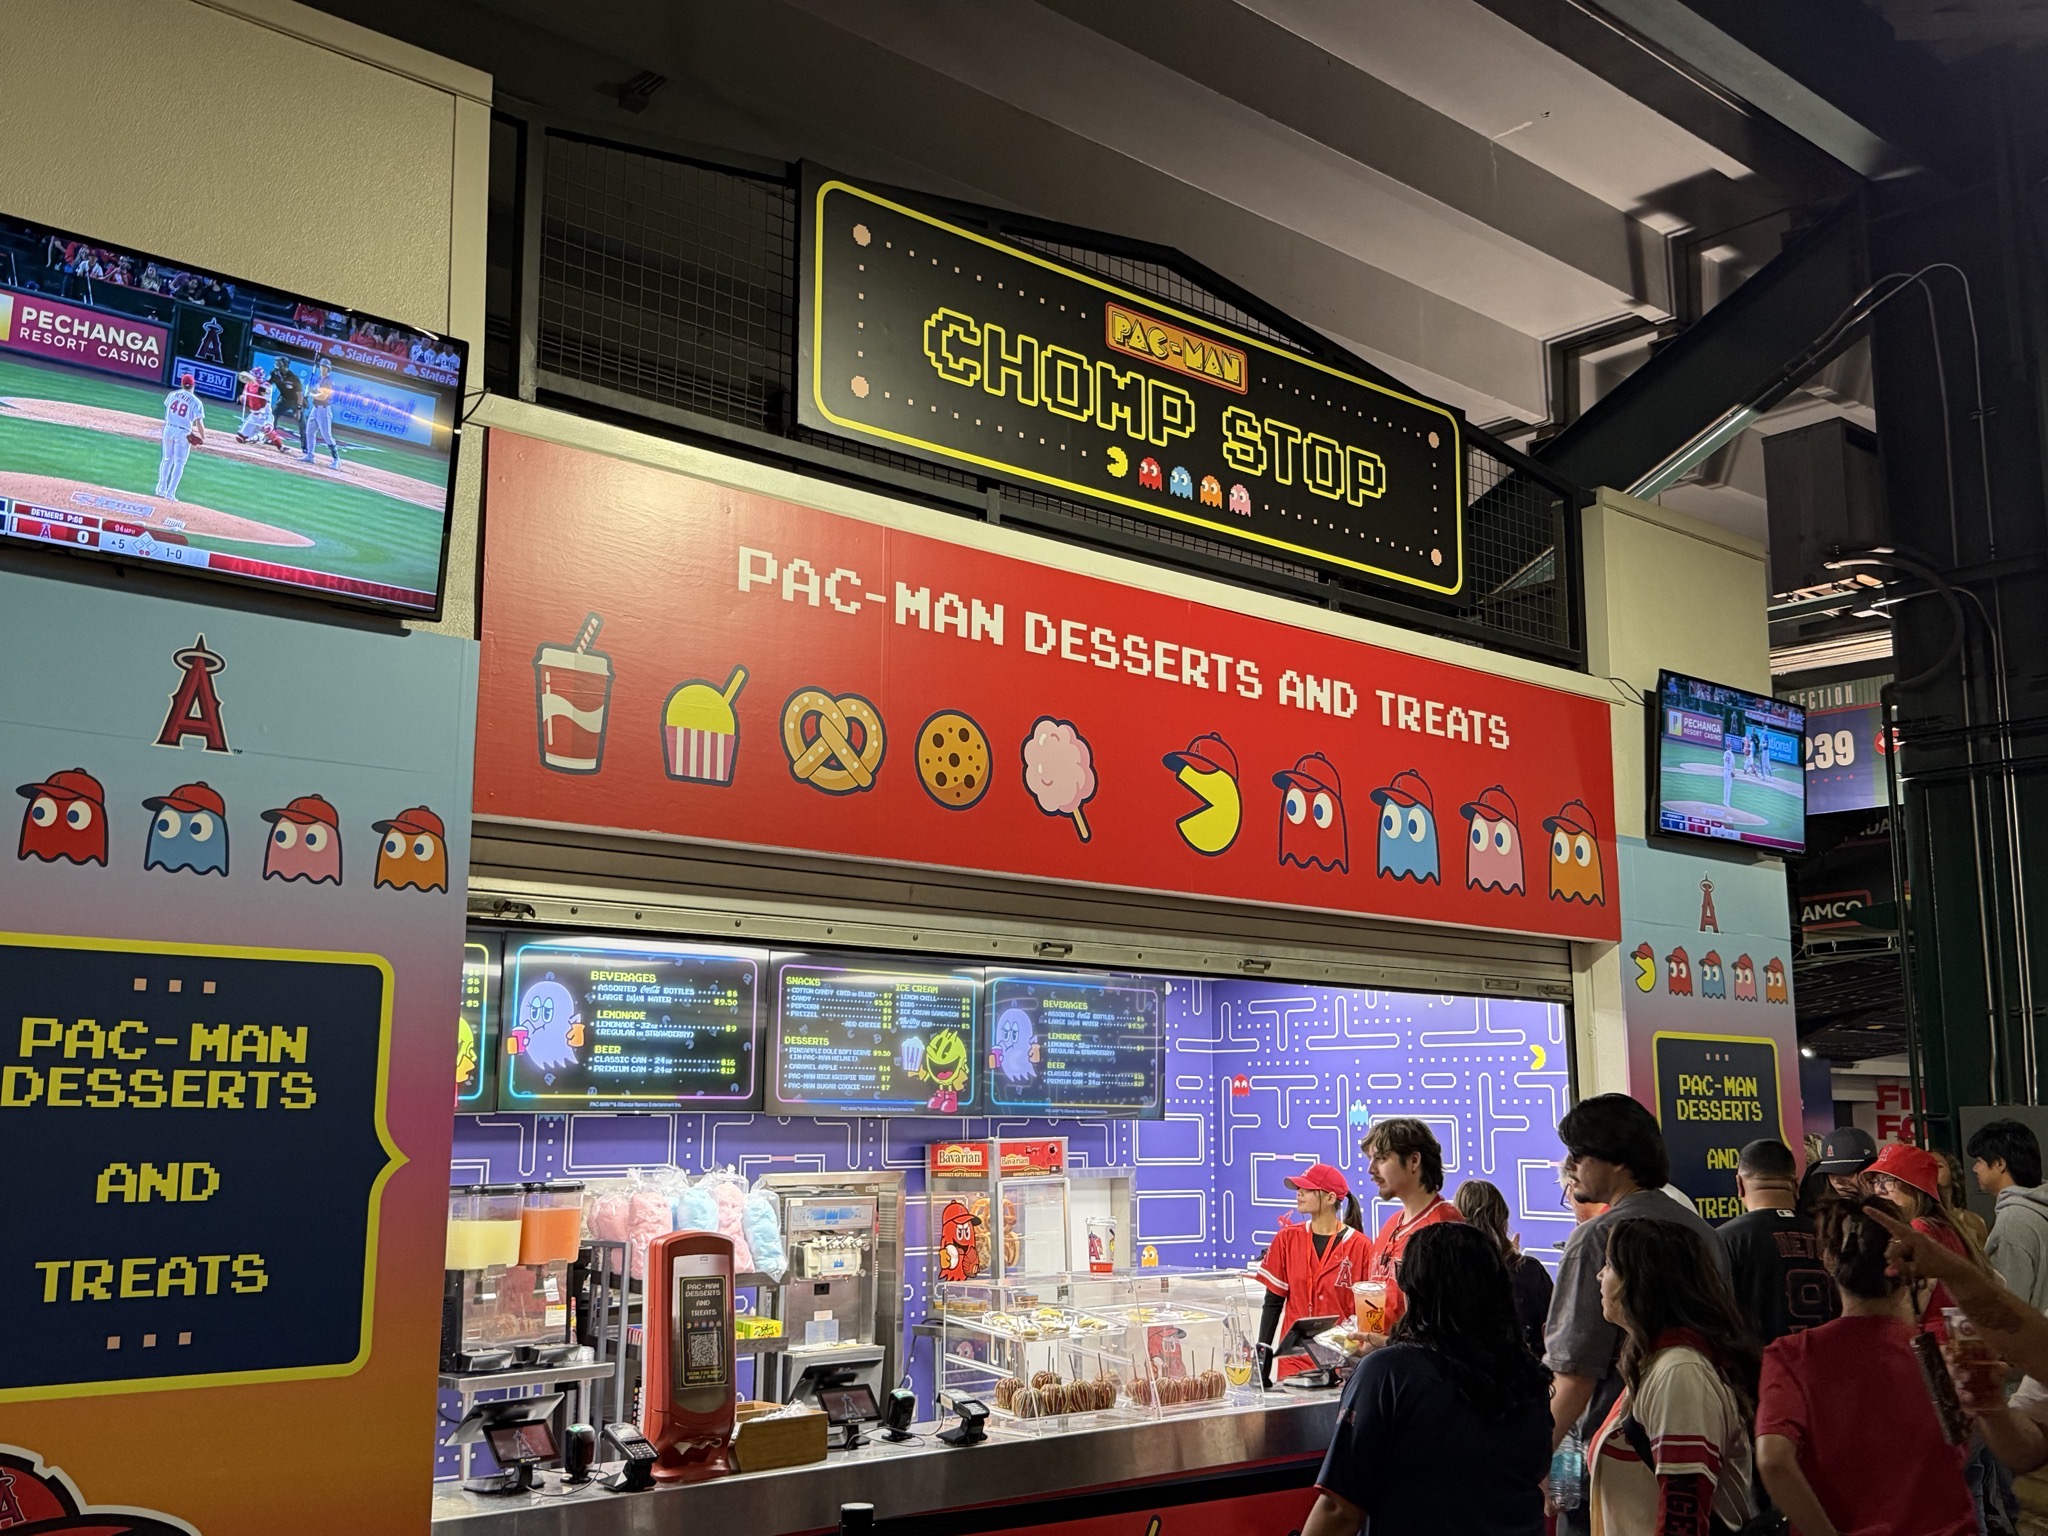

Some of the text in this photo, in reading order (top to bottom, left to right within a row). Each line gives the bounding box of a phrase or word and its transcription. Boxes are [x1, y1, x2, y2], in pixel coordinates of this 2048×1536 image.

[21, 306, 160, 354] PECHANGA
[20, 327, 159, 369] RESORT CASINO
[1111, 310, 1244, 386] PAC-MAN
[198, 371, 228, 387] FBM
[170, 399, 188, 417] 48
[923, 306, 1386, 507] CHOMP STOP
[341, 409, 408, 434] Car Rental
[31, 507, 64, 521] DETMERS
[77, 530, 89, 544] 0
[118, 539, 125, 549] 5
[166, 547, 182, 560] 1-0
[738, 545, 1510, 750] PAC-MAN DESSERTS AND TREATS
[1683, 717, 1721, 735] PECHANGA
[1768, 739, 1793, 754] ational
[590, 971, 656, 983] BEVERAGES
[786, 976, 821, 986] SNACKS
[663, 987, 695, 995] BOTTLES
[895, 984, 938, 994] ICE CREAM
[714, 998, 738, 1006] $9.50
[1043, 1000, 1088, 1010] BEVERAGES
[597, 1010, 646, 1020] LEMONADE
[596, 1028, 635, 1037] (REGULAR
[1048, 1032, 1081, 1040] LEMONADE
[19, 1017, 308, 1063] PAC-MAN
[784, 1036, 829, 1046] DESSERTS
[594, 1045, 621, 1054] BEER
[631, 1065, 647, 1073] CAN
[0, 1066, 317, 1109] DESSERTS
[1679, 1074, 1757, 1097] PAC-MAN
[1676, 1099, 1762, 1121] DESSERTS
[939, 1151, 980, 1163] Bavarian
[1001, 1156, 1029, 1164] Bavarian
[1707, 1148, 1739, 1169] AND
[96, 1163, 220, 1203] AND
[35, 1254, 268, 1302] TREATS
